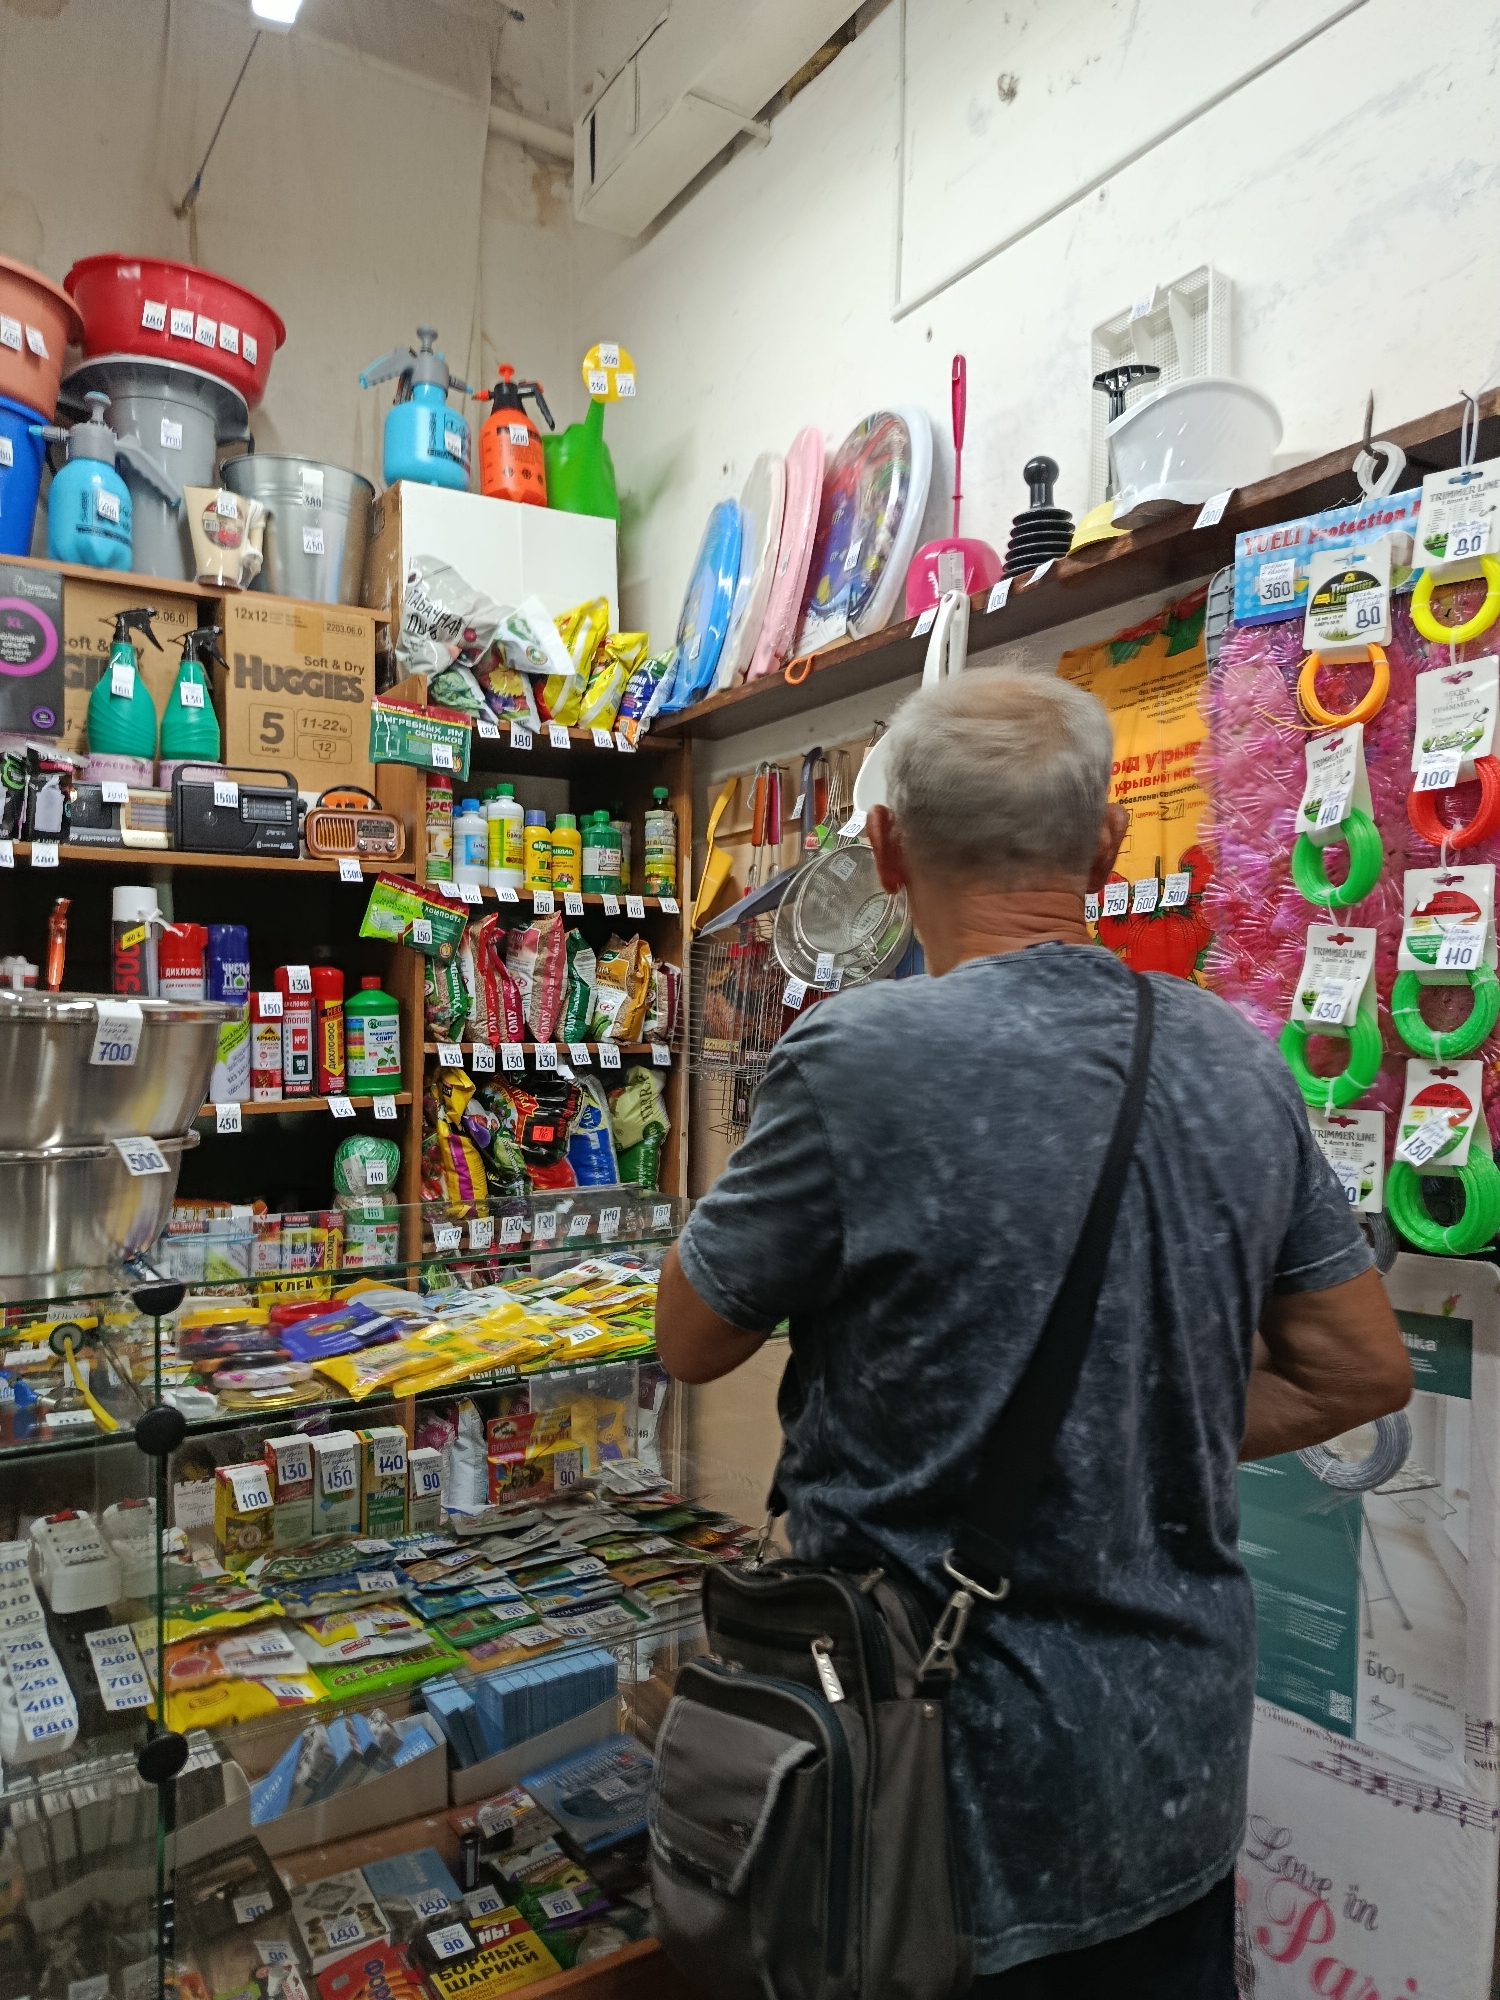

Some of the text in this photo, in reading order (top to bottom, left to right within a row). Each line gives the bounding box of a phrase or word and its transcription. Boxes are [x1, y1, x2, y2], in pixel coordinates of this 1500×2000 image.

[601, 354, 618, 366] 300
[1429, 479, 1500, 503] TRIMMER LINE
[1203, 509, 1222, 526] 200
[1243, 524, 1303, 557] YUELI
[1306, 507, 1406, 545] Protection
[1453, 535, 1482, 557] 80
[1261, 580, 1291, 600] 360
[1330, 578, 1375, 597] Trimmer
[1356, 605, 1381, 629] 80
[304, 655, 365, 676] Soft & Dry
[1431, 698, 1480, 714] ТРИММЕРА
[259, 711, 285, 745] 5
[317, 741, 332, 753] 12
[513, 733, 531, 748] 180
[1312, 744, 1353, 770] TRIMMER LINE
[1420, 769, 1451, 788] 100
[1136, 896, 1155, 910] 600
[1167, 890, 1187, 903] 500
[536, 901, 550, 913] 150
[568, 903, 582, 914] 160
[1106, 898, 1126, 913] 750
[417, 930, 431, 942] 150
[1312, 946, 1367, 960] TRIMMER LINE
[1445, 947, 1473, 966] 110
[816, 967, 831, 981] 230
[292, 979, 310, 991] 130
[784, 992, 802, 1008] 300
[263, 1003, 280, 1015] 150
[1315, 1001, 1342, 1020] 130
[506, 1008, 519, 1034] ОМУ
[100, 1041, 131, 1062] 700
[443, 1053, 462, 1065] 130
[573, 1052, 589, 1063] 130
[475, 1055, 494, 1069] 130
[505, 1054, 523, 1068] 130
[539, 1055, 556, 1069] 130
[603, 1054, 619, 1067] 140
[379, 1106, 394, 1117] 150
[219, 1117, 238, 1131] 450
[1311, 1129, 1377, 1143] TRIMMER LINE
[1403, 1136, 1433, 1161] 130
[127, 1152, 162, 1172] 500
[369, 1171, 385, 1183] 110
[574, 1328, 598, 1342] 50
[379, 1455, 404, 1472] 140
[281, 1462, 307, 1482] 130
[326, 1470, 352, 1488] 150
[560, 1470, 576, 1486] 90
[423, 1472, 440, 1491] 90
[242, 1491, 268, 1508] 100
[6, 1640, 44, 1655] 700
[107, 1673, 143, 1689] 700
[23, 1695, 65, 1714] 400
[419, 1897, 449, 1916] 180
[552, 1899, 573, 1915] 60
[1343, 1883, 1379, 1932] in
[330, 1924, 360, 1944] 180
[443, 1938, 465, 1954] 90
[438, 1939, 530, 1981] БОРНЫЕ
[443, 1950, 540, 1994] ШАРИКИ
